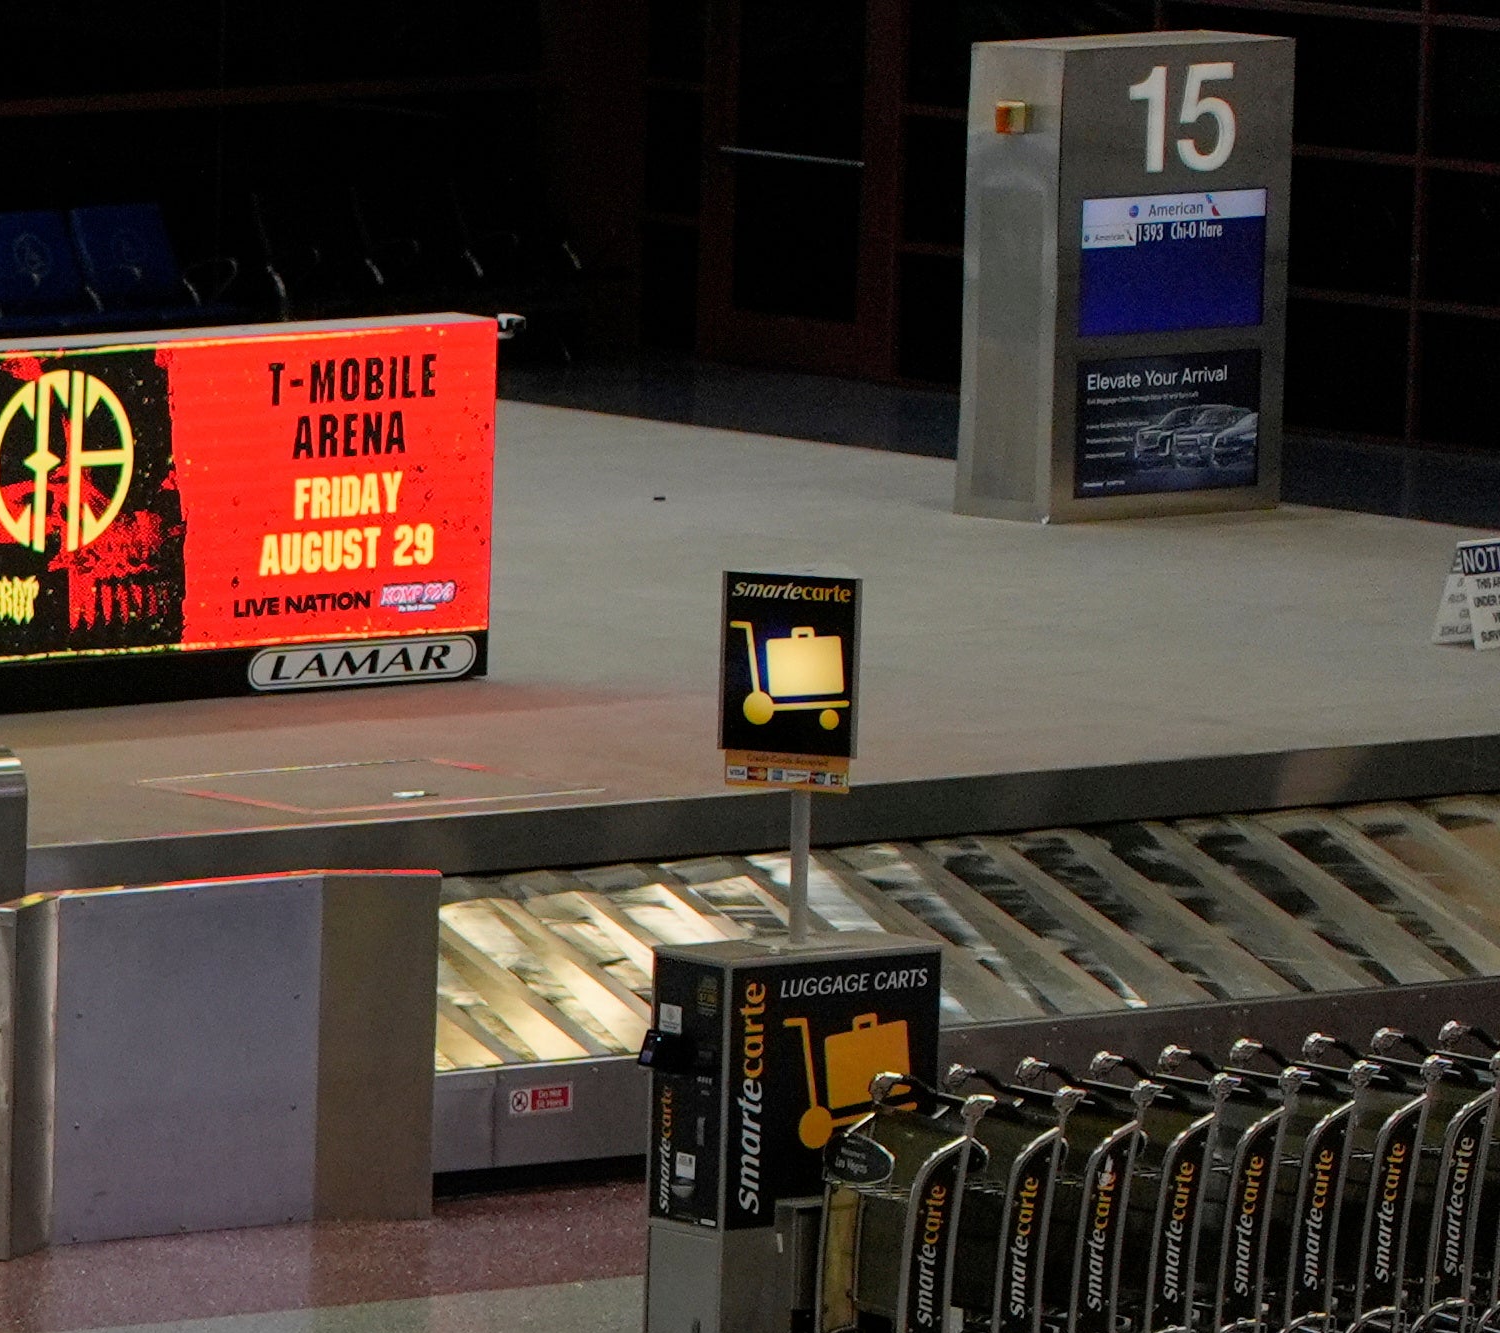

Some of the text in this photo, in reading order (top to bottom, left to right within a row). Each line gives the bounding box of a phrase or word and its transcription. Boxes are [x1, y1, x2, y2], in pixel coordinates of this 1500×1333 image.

[1128, 61, 1238, 174] 15
[1136, 222, 1164, 242] 1393
[1199, 220, 1224, 239] Hare
[1148, 201, 1204, 217] American
[268, 354, 437, 406] T-MOBILE
[1086, 364, 1228, 392] Elevate Your Arrival
[292, 411, 406, 460] ARENA
[294, 471, 403, 520] FRIDAY
[259, 523, 434, 577] AUGUST 29
[233, 591, 371, 618] LIVE NATION
[732, 581, 852, 603] smartecarte
[270, 645, 450, 681] LAMAR
[780, 968, 929, 998] LUGGAGE CARTS
[738, 979, 766, 1215] smartecarte
[1163, 1161, 1195, 1303] smartecarte
[1233, 1155, 1264, 1297] smartecarte
[1303, 1149, 1334, 1291] smartecarte
[1374, 1142, 1406, 1283] smartecarte
[1444, 1136, 1475, 1277] smartecarte
[916, 1184, 947, 1328] smartecarte
[1009, 1175, 1039, 1319] smartecarte
